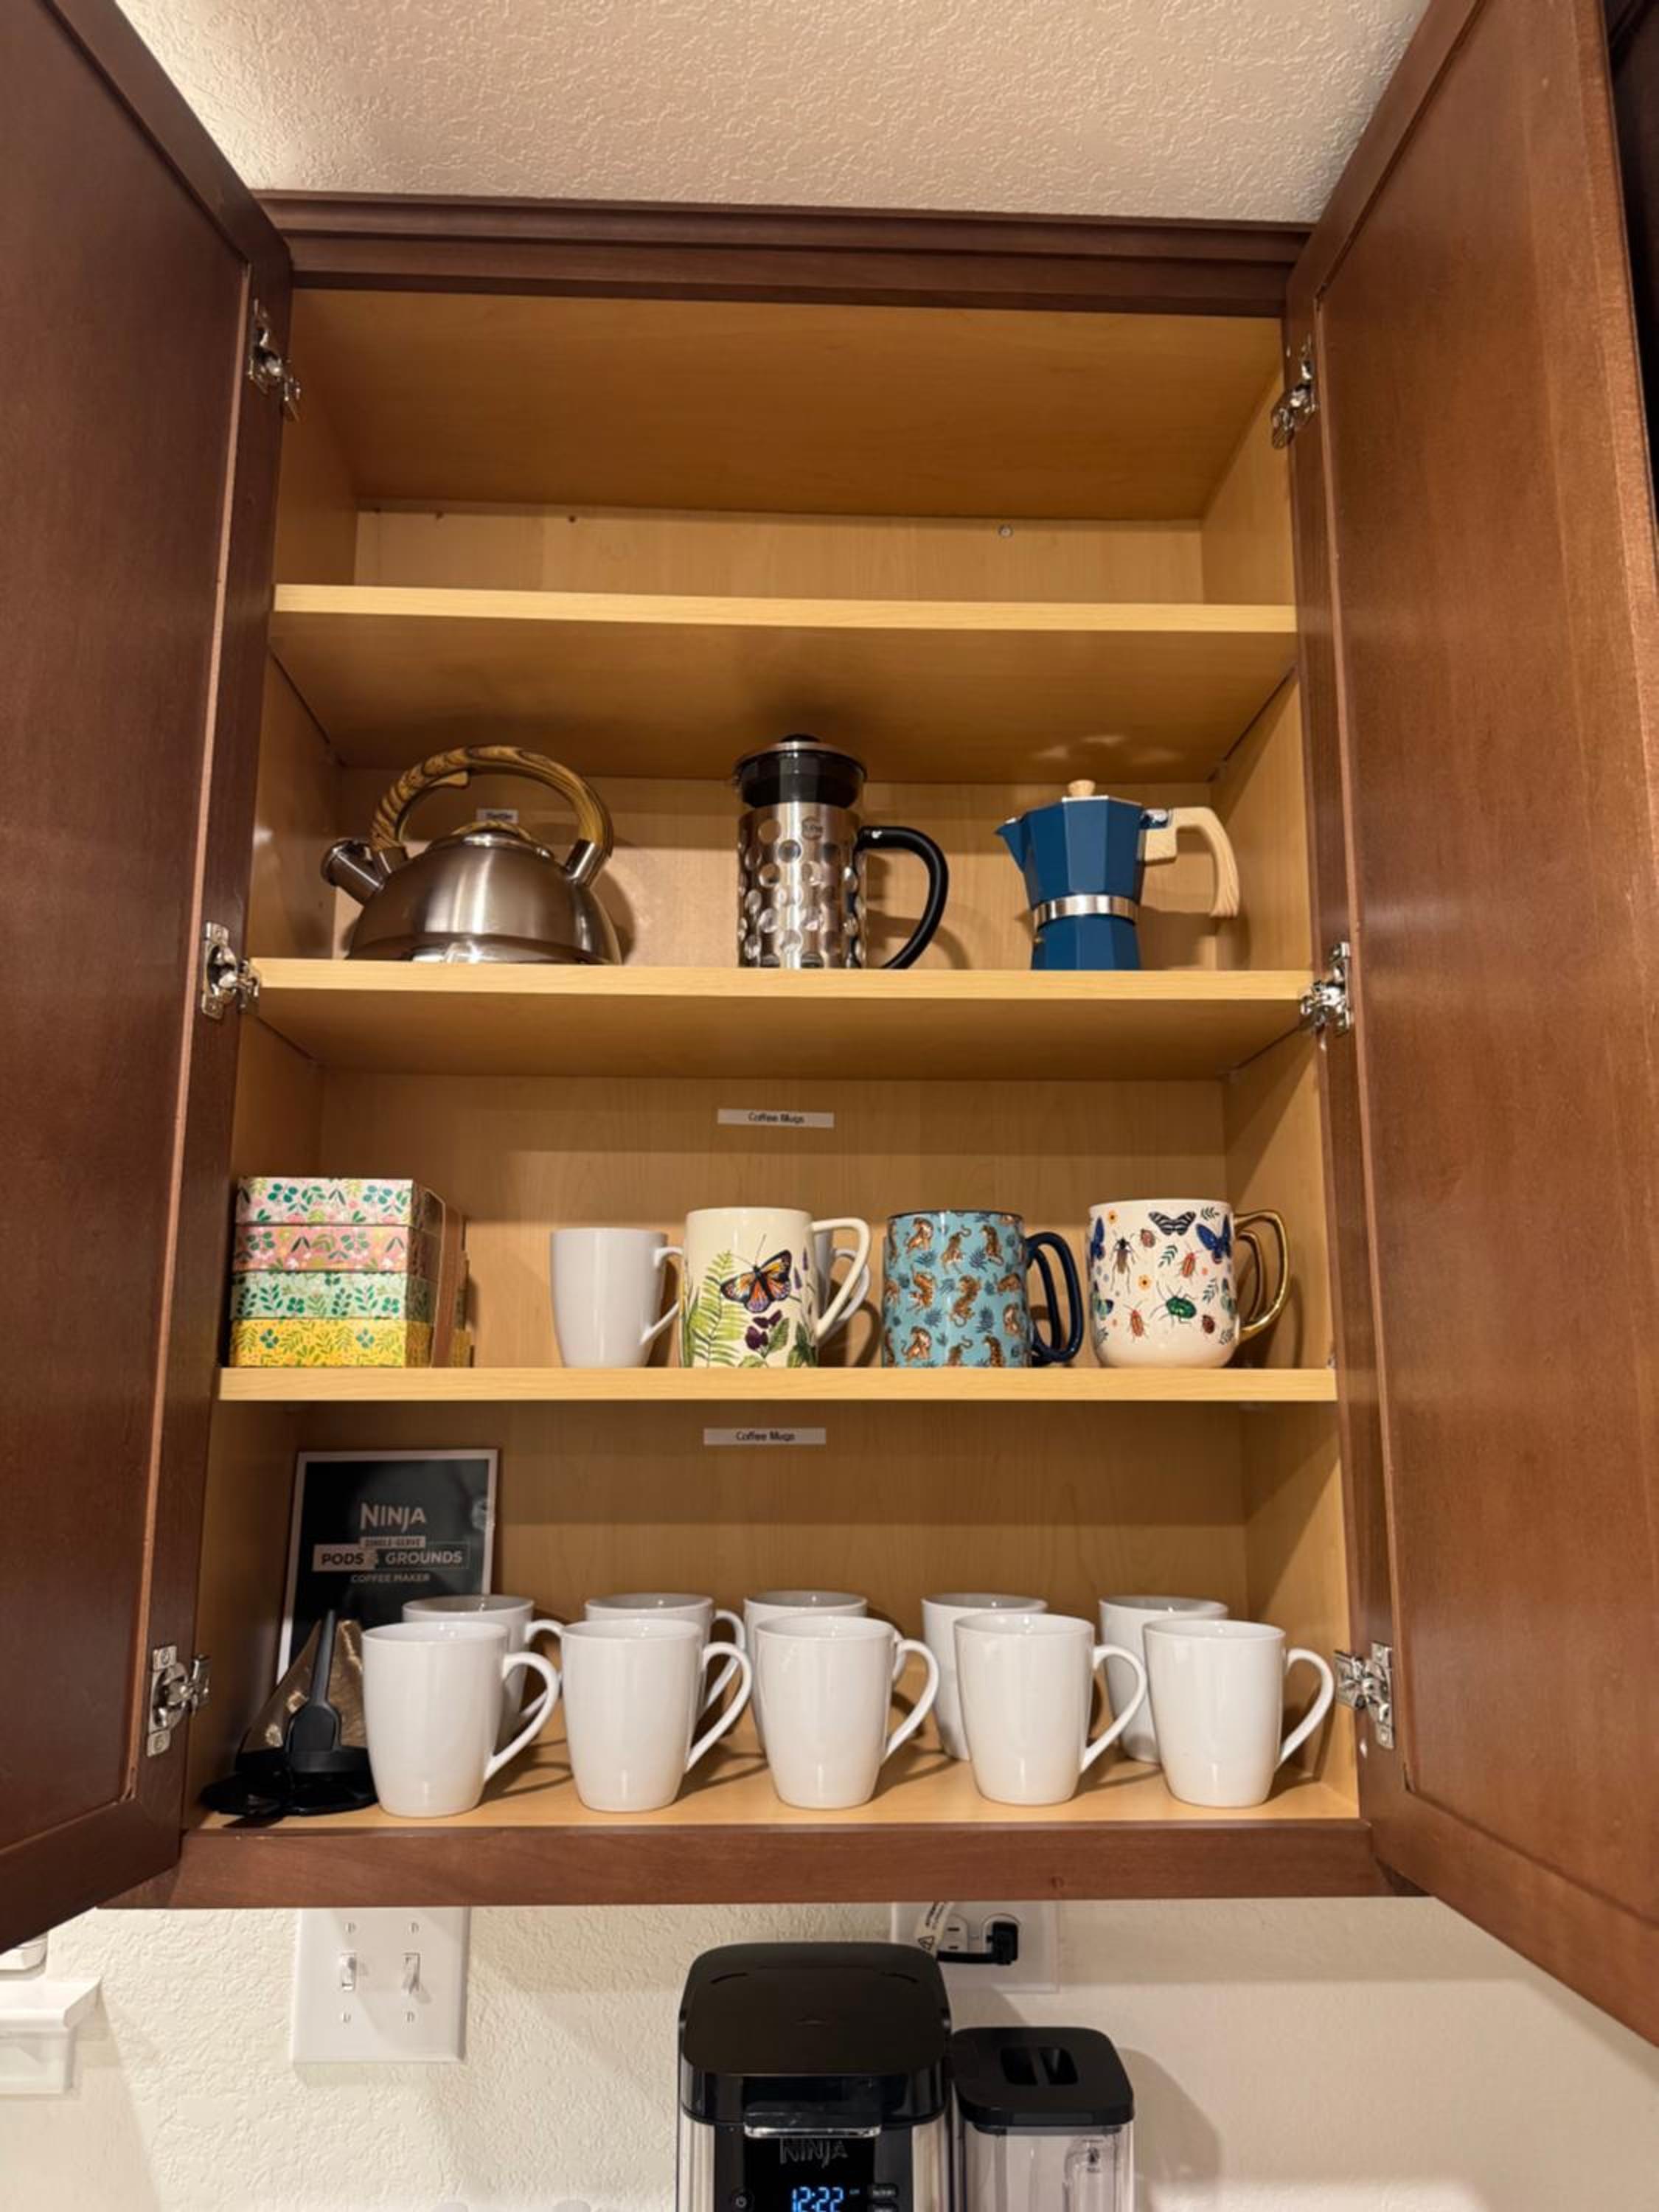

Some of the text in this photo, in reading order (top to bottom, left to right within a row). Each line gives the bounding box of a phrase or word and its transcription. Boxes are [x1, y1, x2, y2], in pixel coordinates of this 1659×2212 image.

[748, 1111, 804, 1124] Coffee Mugs
[736, 1430, 796, 1441] Coffee Mugs
[360, 1503, 426, 1531] NINJA
[321, 1551, 463, 1565] PODS GROUNDS
[350, 1573, 430, 1583] COFFEE MAKER
[779, 2138, 848, 2168] NINJA
[792, 2187, 844, 2212] 12:22
